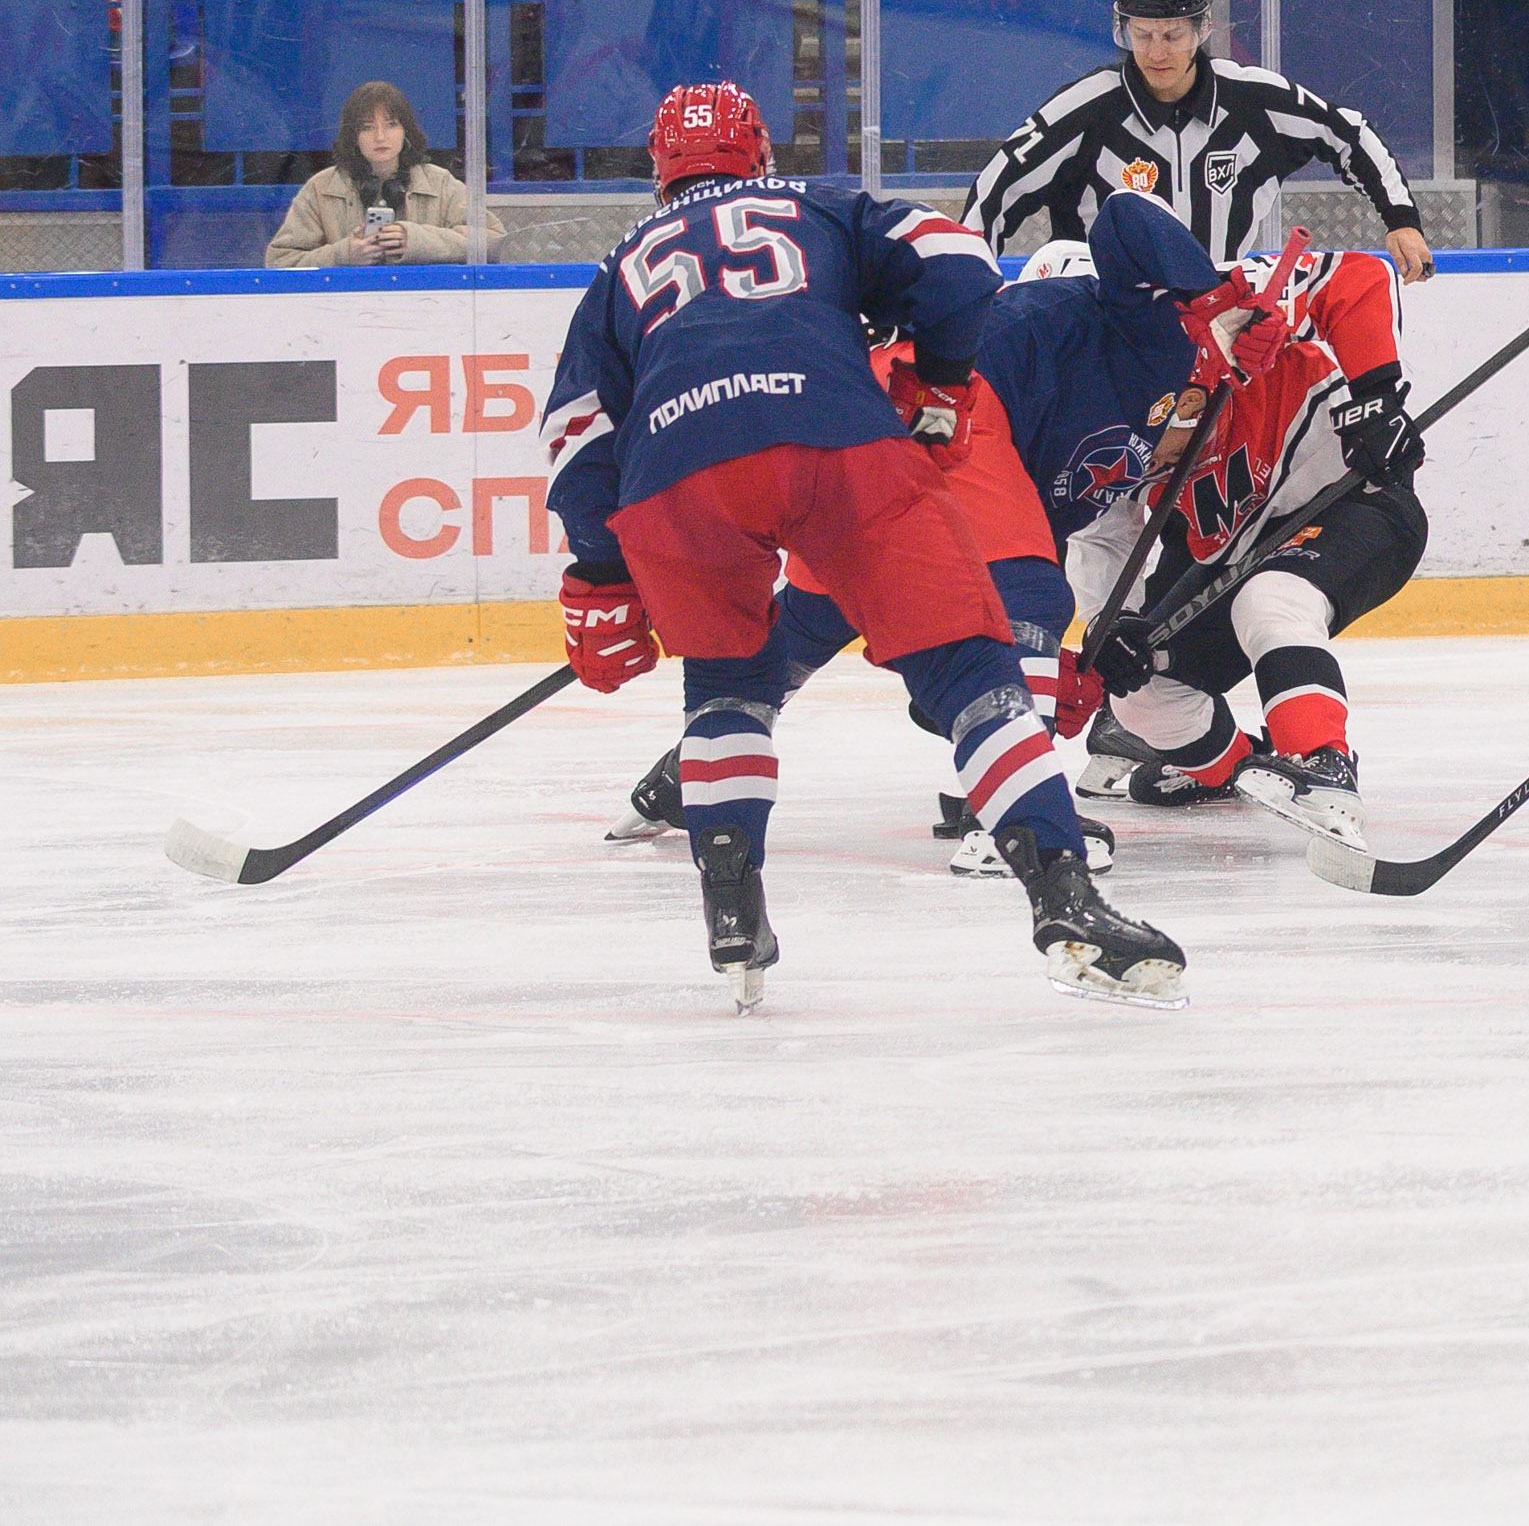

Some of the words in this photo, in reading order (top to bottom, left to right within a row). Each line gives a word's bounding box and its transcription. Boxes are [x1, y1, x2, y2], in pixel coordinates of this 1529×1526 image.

[683, 104, 713, 128] 55
[1295, 82, 1329, 112] 7
[1132, 168, 1149, 188] 80
[1208, 158, 1235, 181] ВХЛ
[618, 197, 808, 336] 55
[377, 353, 566, 435] ЯБ
[649, 373, 806, 435] ПОЛИПЛАСТ
[930, 386, 958, 405] CCM
[1331, 397, 1386, 432] UER
[1128, 431, 1153, 472] ЮЖН
[378, 477, 570, 560] СП
[1147, 547, 1262, 646] SOYUZ
